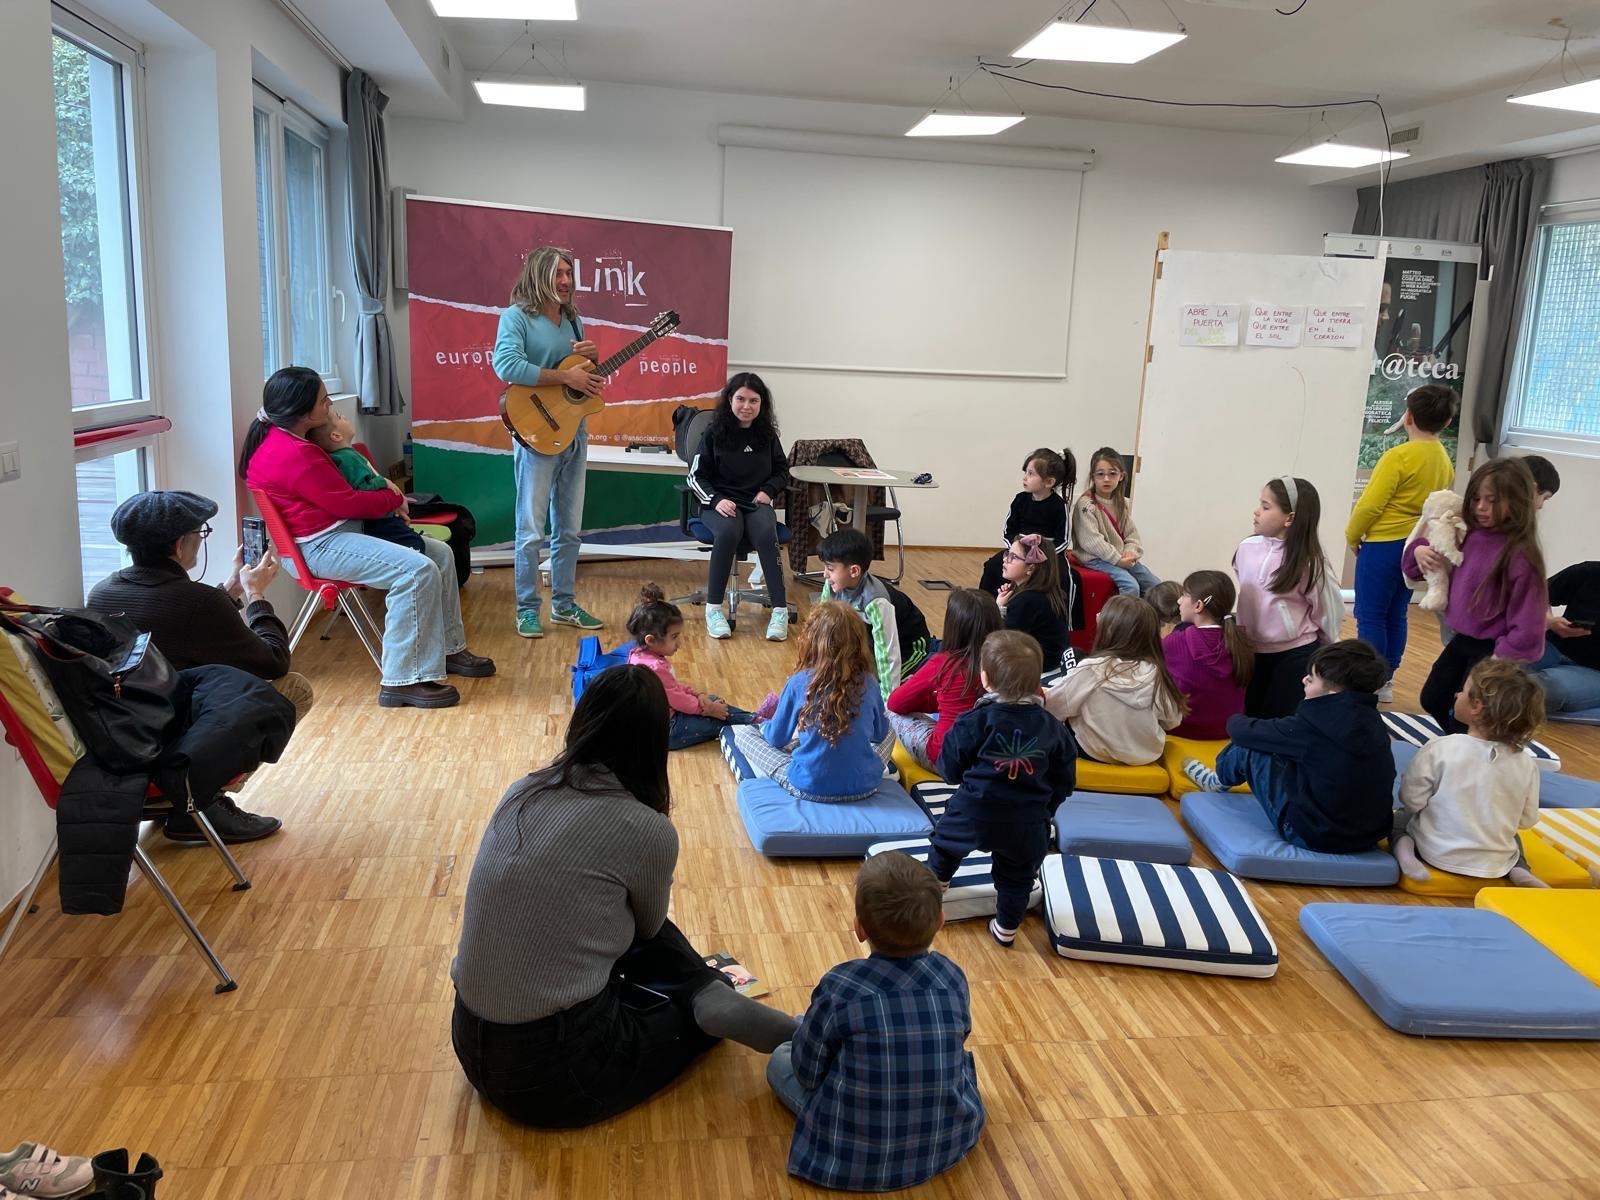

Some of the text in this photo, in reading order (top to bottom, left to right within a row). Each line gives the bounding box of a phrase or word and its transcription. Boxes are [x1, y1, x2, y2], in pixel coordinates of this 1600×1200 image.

[1187, 308, 1228, 317] ABRE LA
[1273, 310, 1293, 318] ENTRE
[1193, 319, 1224, 327] PUERTA
[436, 350, 697, 376] europ people
[1370, 352, 1461, 380] r@teca
